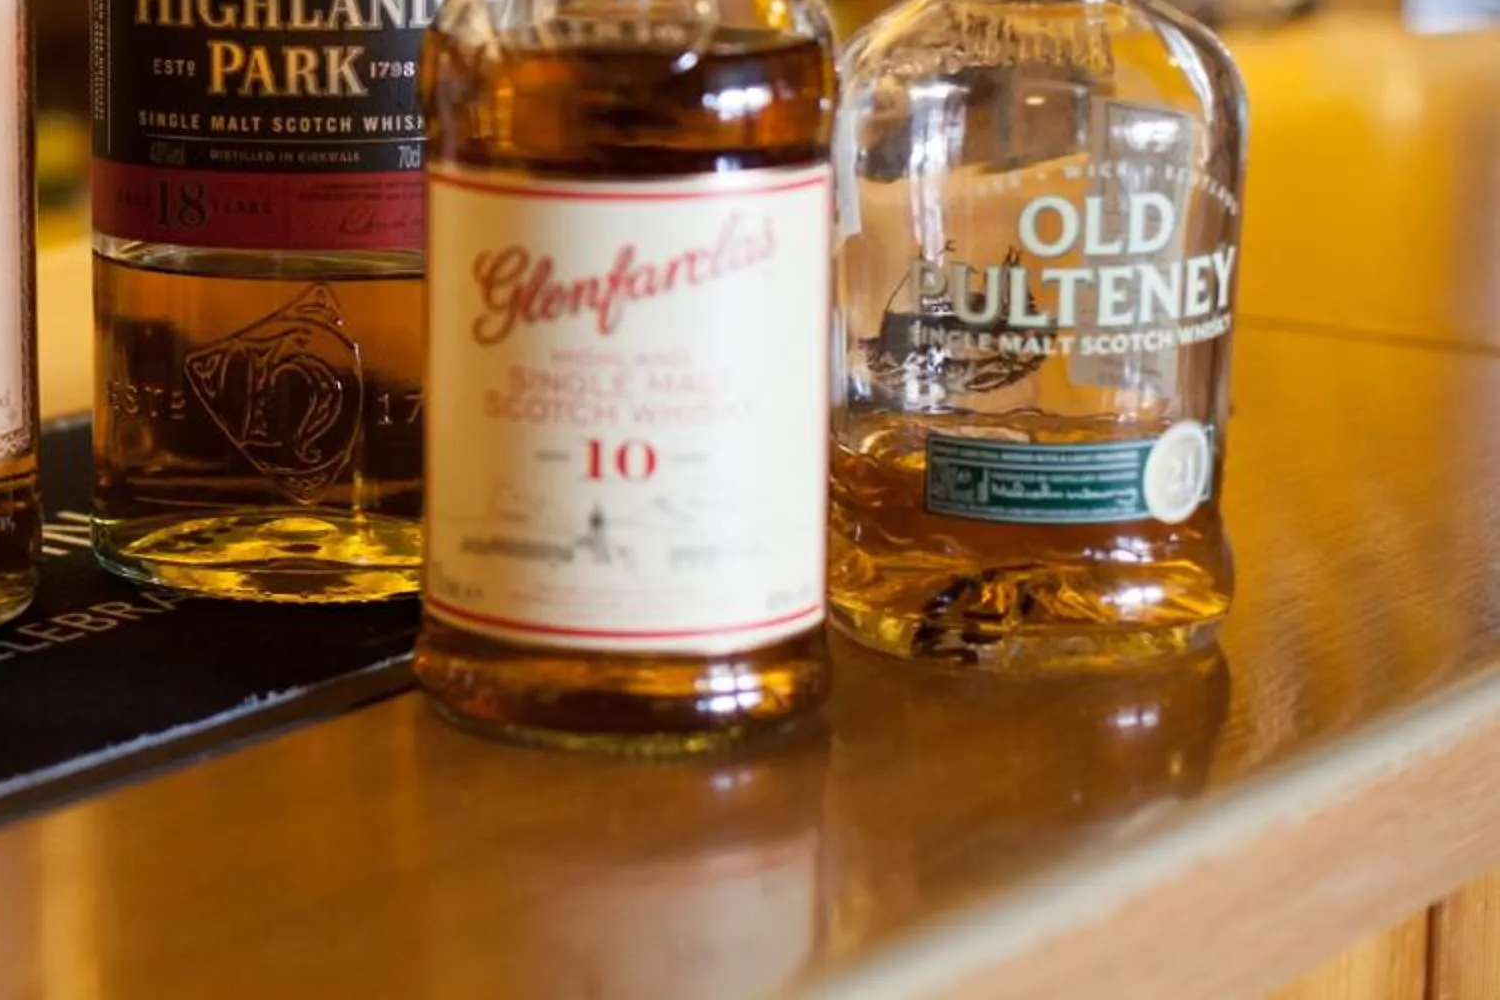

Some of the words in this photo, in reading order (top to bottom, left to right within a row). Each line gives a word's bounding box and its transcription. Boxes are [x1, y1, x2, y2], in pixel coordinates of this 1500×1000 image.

[207, 40, 369, 97] PARK
[369, 60, 416, 79] 1798
[138, 110, 200, 130] SINGLE
[210, 114, 262, 132] MALT
[271, 116, 353, 133] SCOTCH
[154, 180, 208, 227] 18
[1018, 192, 1176, 258] OLD
[472, 210, 778, 346] Glenfarclas
[910, 244, 1237, 329] PULTENEY
[999, 332, 1074, 357] MALT
[1080, 328, 1174, 356] SCOTCH
[586, 439, 658, 481] 10
